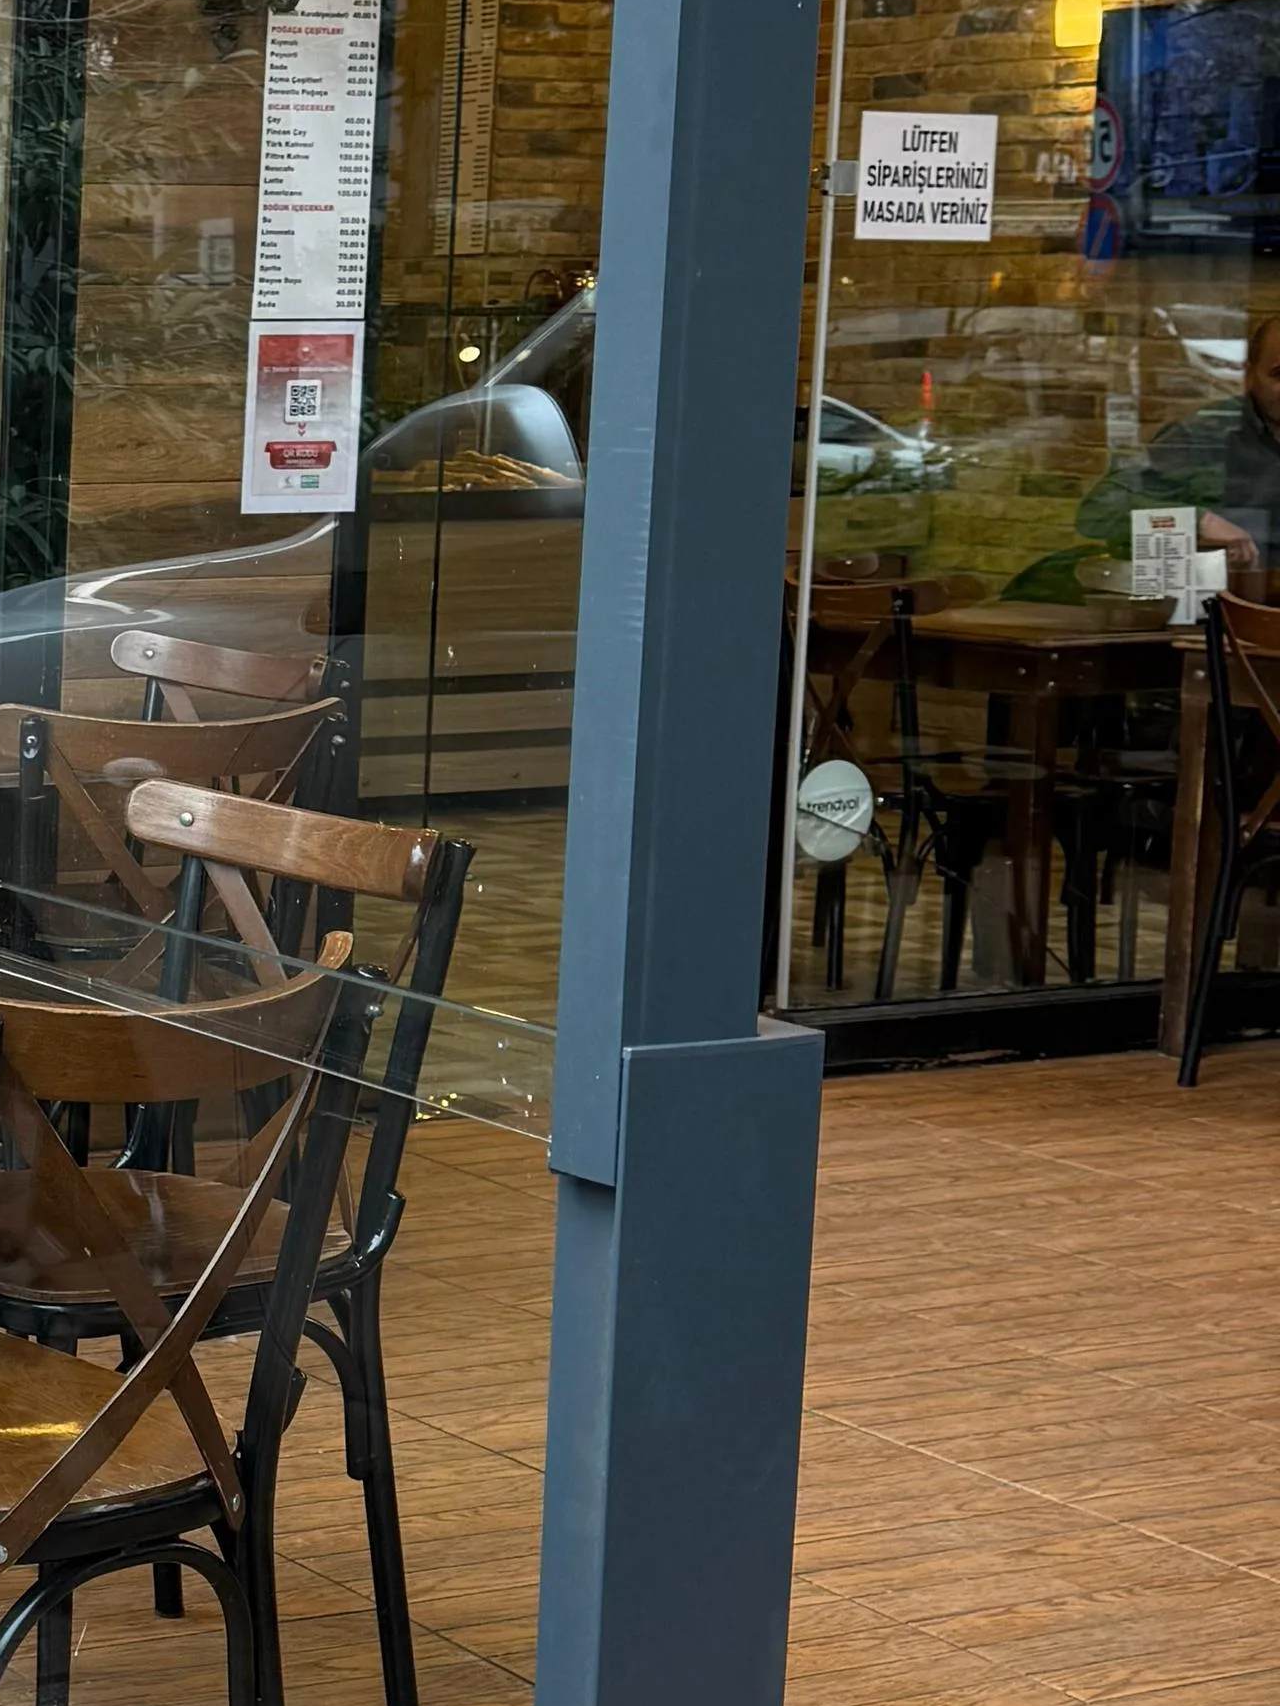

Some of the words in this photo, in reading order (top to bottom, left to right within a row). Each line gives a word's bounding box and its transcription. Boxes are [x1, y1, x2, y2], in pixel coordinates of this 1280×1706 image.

[271, 25, 302, 34] POĞAÇA
[267, 116, 281, 124] Çay
[293, 128, 307, 137] Çay
[902, 124, 959, 153] LÜTFEN
[265, 152, 284, 160] Filtre
[866, 159, 989, 194] SİPARİŞLERİNİZİ
[263, 203, 289, 211] SOĞUK
[862, 200, 926, 224] MASADA
[930, 197, 989, 225] VERİNİZ
[259, 277, 282, 285] Meyve
[284, 277, 302, 285] Suyu
[258, 289, 280, 297] Ayran
